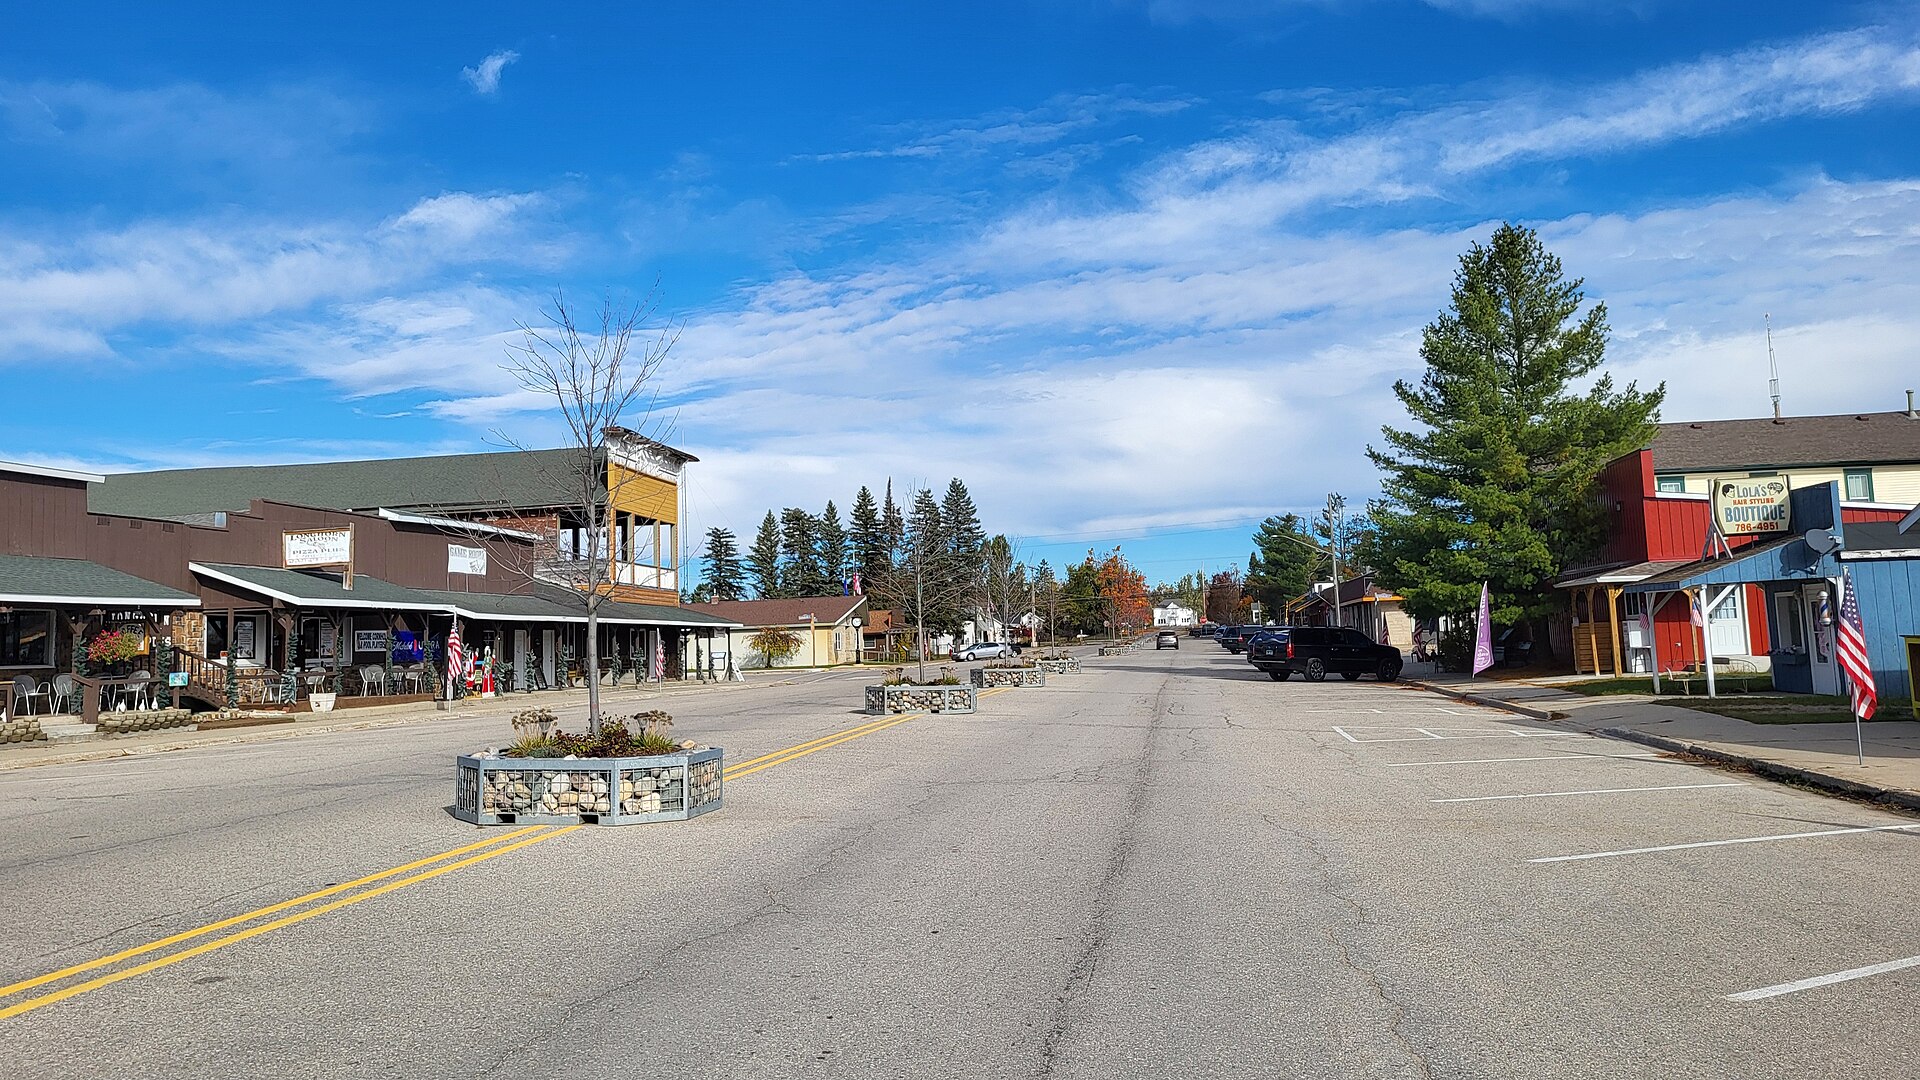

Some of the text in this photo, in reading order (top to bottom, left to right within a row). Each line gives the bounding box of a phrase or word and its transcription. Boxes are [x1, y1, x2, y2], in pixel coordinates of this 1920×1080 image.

[1736, 485, 1767, 498] LOLA'S
[1724, 505, 1786, 522] BOUTIQUE
[1735, 522, 1779, 532] 786-4951
